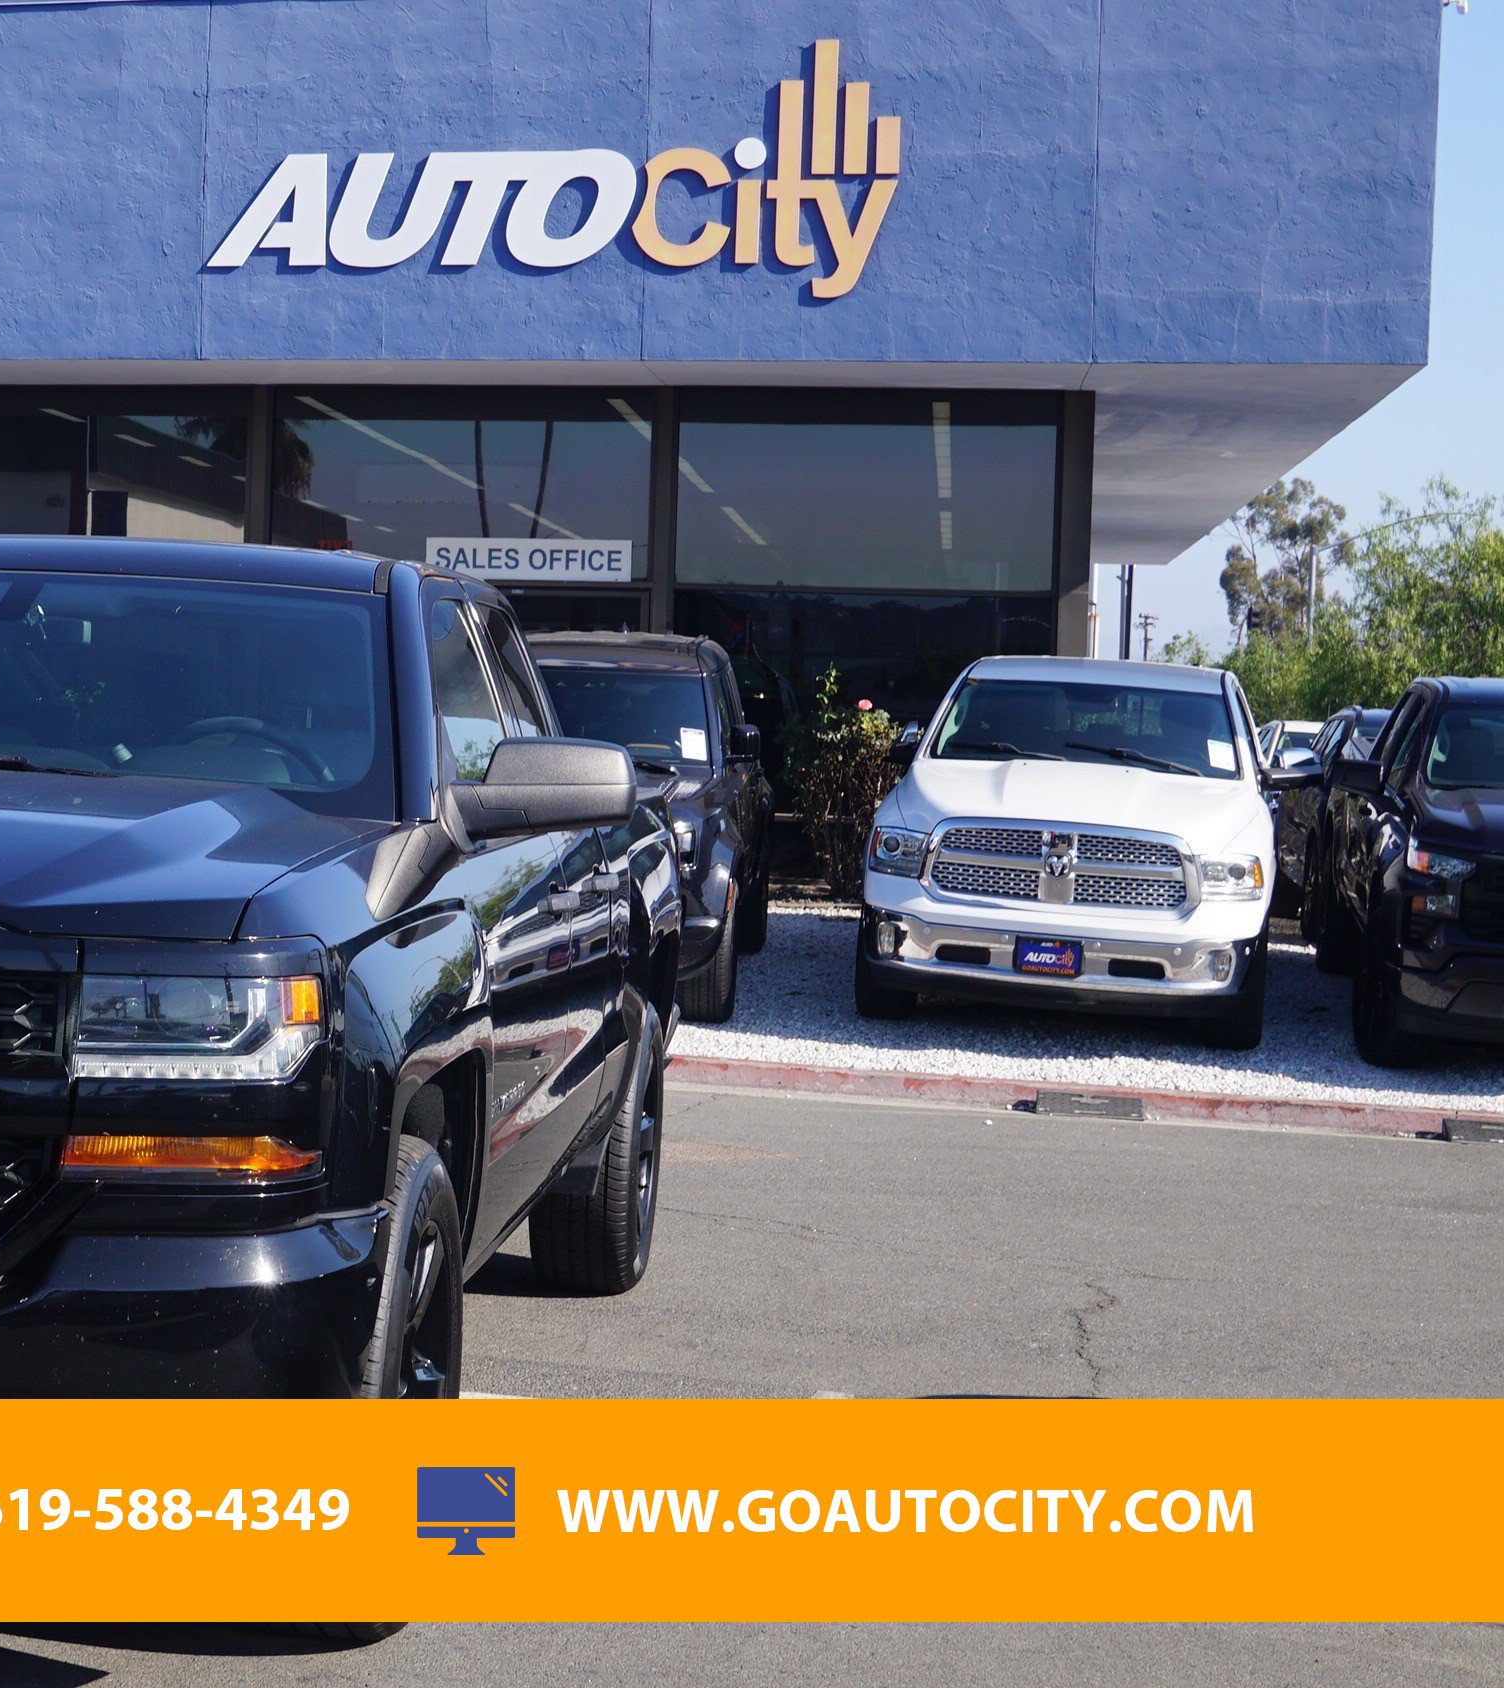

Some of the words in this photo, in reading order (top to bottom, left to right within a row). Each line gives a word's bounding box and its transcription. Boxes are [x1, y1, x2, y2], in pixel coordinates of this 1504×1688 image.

[435, 547, 520, 571] SALES
[528, 548, 623, 572] OFFICE
[1022, 965, 1075, 975] GOAUTOCITY.COM
